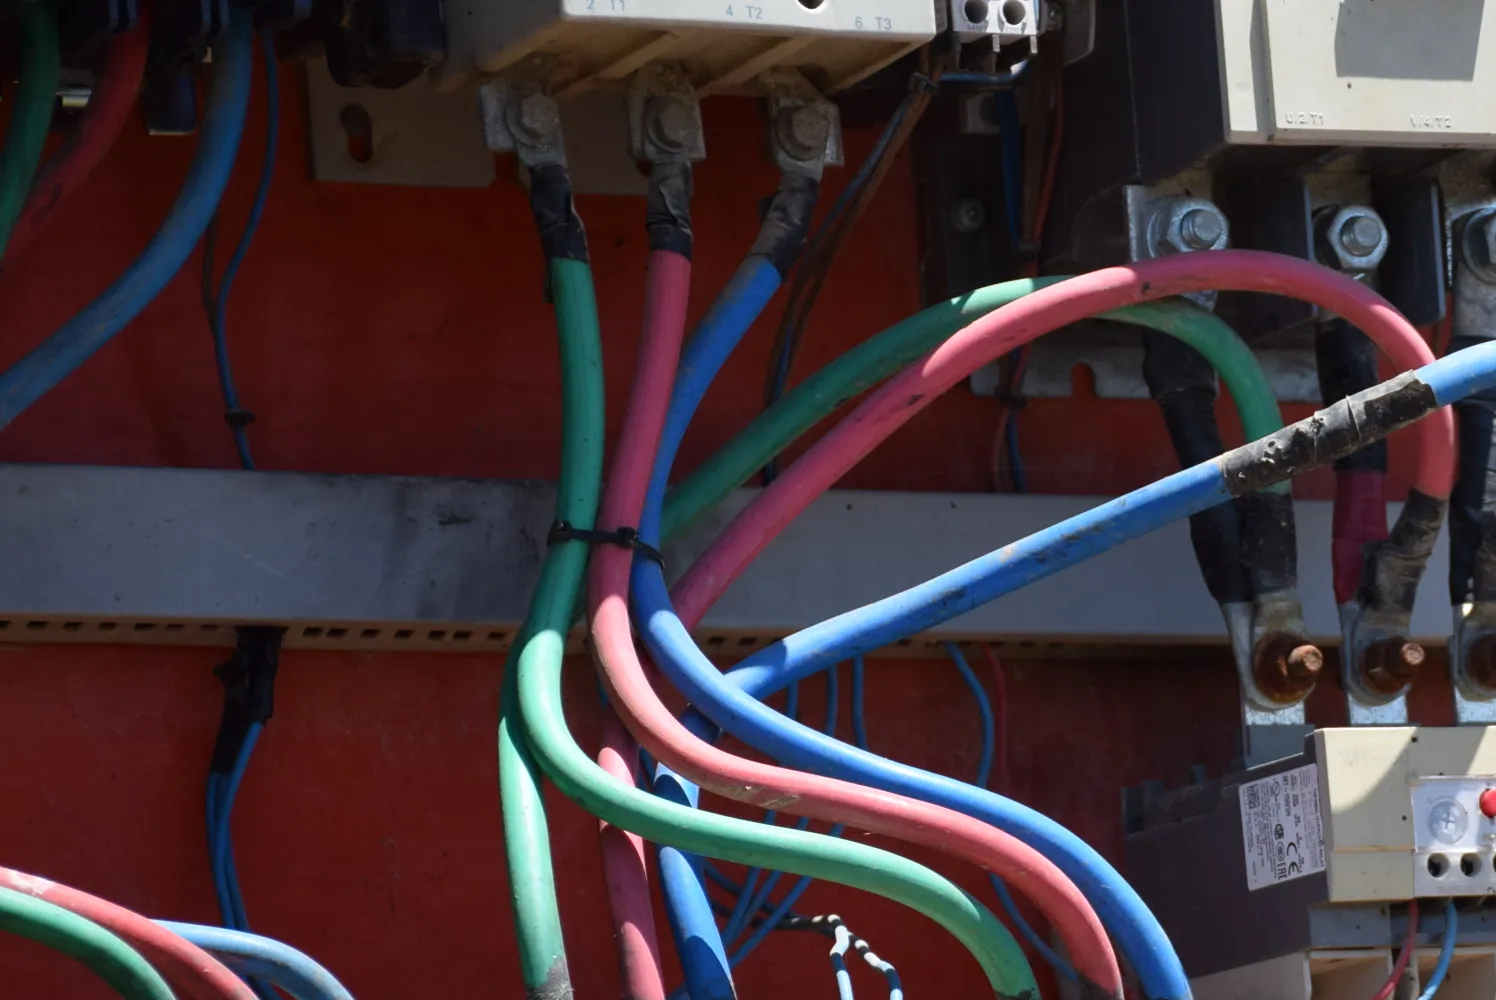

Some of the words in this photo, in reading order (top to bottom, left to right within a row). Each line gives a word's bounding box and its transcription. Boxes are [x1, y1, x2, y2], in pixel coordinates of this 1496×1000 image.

[725, 5, 734, 17] 4
[746, 5, 763, 19] T2
[854, 16, 863, 29] 6
[874, 16, 892, 30] T3
